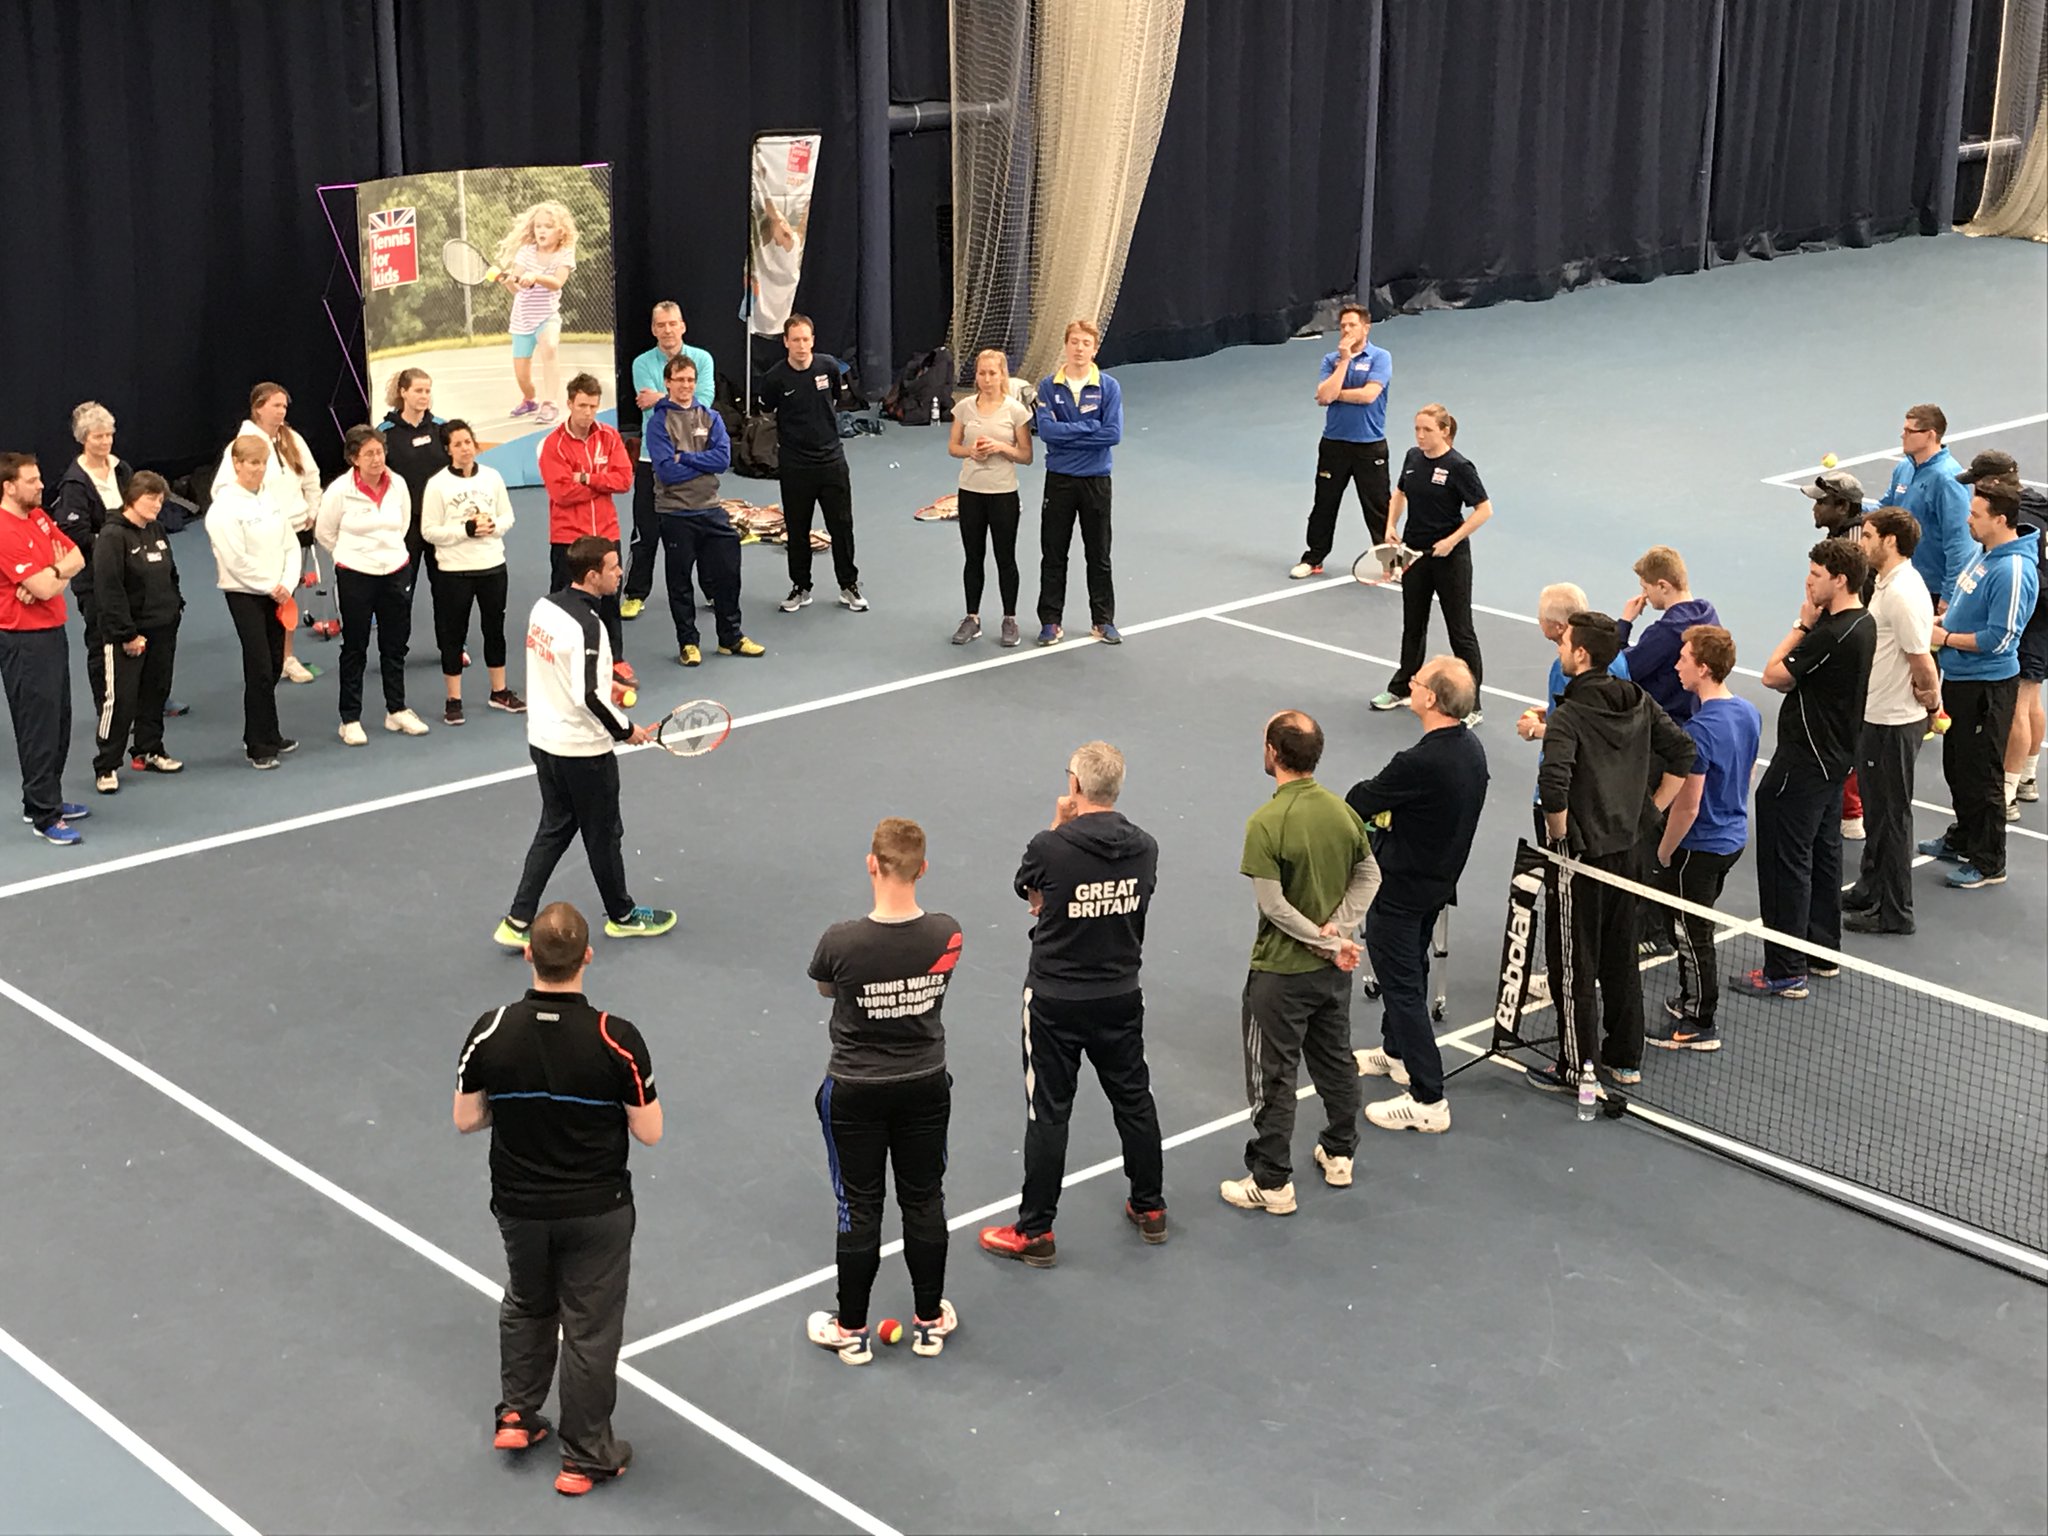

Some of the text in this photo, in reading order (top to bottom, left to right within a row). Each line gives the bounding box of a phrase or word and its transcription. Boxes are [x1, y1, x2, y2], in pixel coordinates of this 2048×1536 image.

[371, 229, 411, 250] Tennis
[372, 252, 390, 268] for
[373, 267, 400, 287] kids
[531, 623, 554, 648] GREAT
[1075, 878, 1138, 901] GREAT
[1068, 895, 1141, 918] BRITAIN
[856, 984, 946, 1008] YOUNG COACHES
[863, 974, 945, 996] TENNIS WALES
